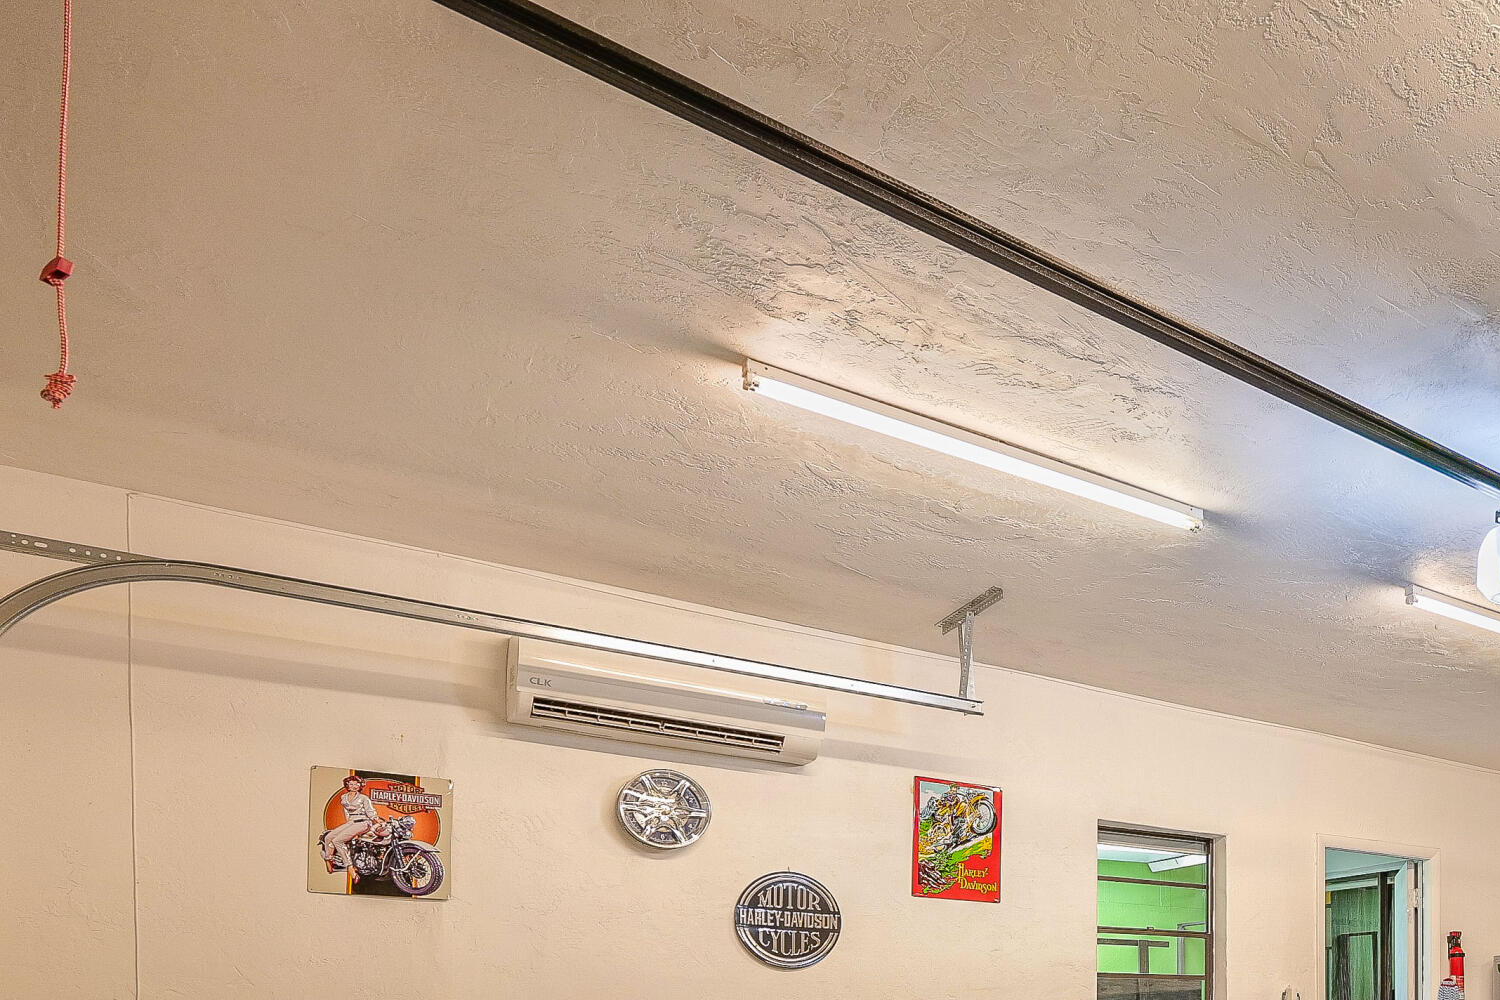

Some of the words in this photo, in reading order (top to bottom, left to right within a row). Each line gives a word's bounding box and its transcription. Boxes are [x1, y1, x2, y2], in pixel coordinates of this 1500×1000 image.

[529, 676, 552, 687] CLK
[391, 783, 423, 793] MOTOR
[372, 789, 440, 806] HARLEY-DAVIDSON
[391, 802, 421, 813] CYCLES
[959, 876, 997, 894] DAVIDSON
[757, 882, 821, 911] MOTOR
[739, 907, 839, 930] HARLEY-DAVIDSON
[758, 927, 821, 957] CYCLES
